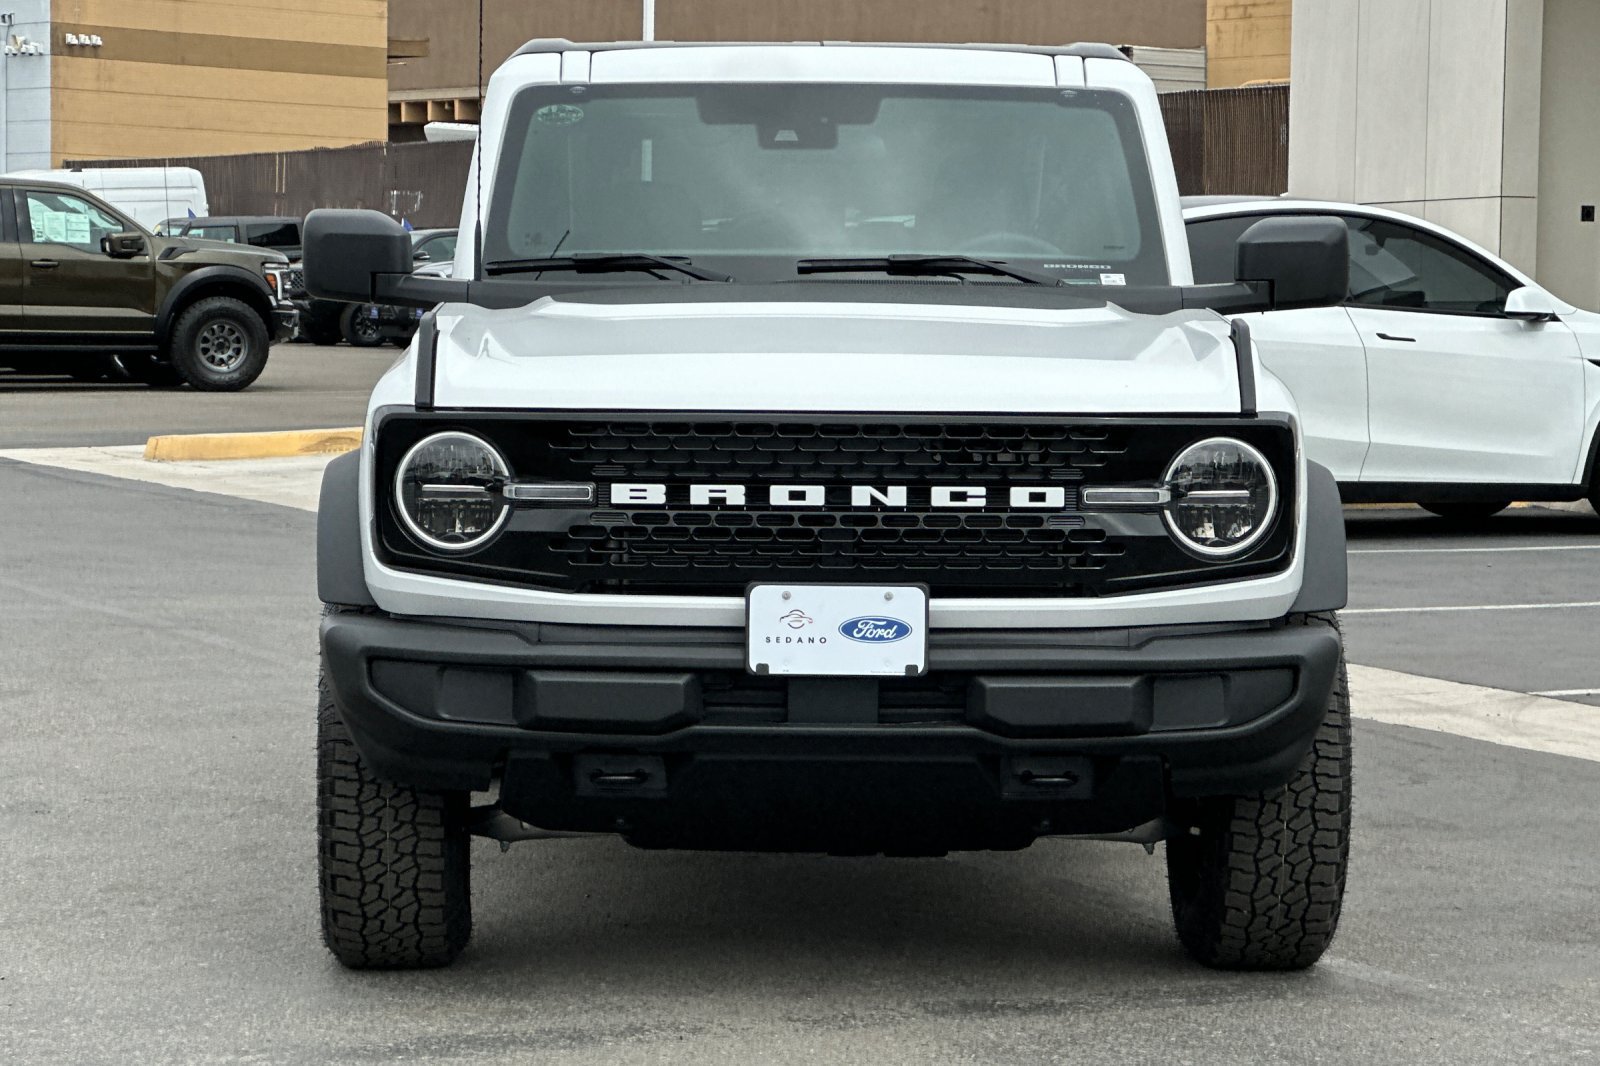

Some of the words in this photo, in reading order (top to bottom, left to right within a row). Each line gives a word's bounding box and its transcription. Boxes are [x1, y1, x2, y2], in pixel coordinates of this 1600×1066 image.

[610, 483, 1065, 507] BRONCO
[853, 619, 898, 638] Ford
[765, 636, 827, 644] SEDANO
